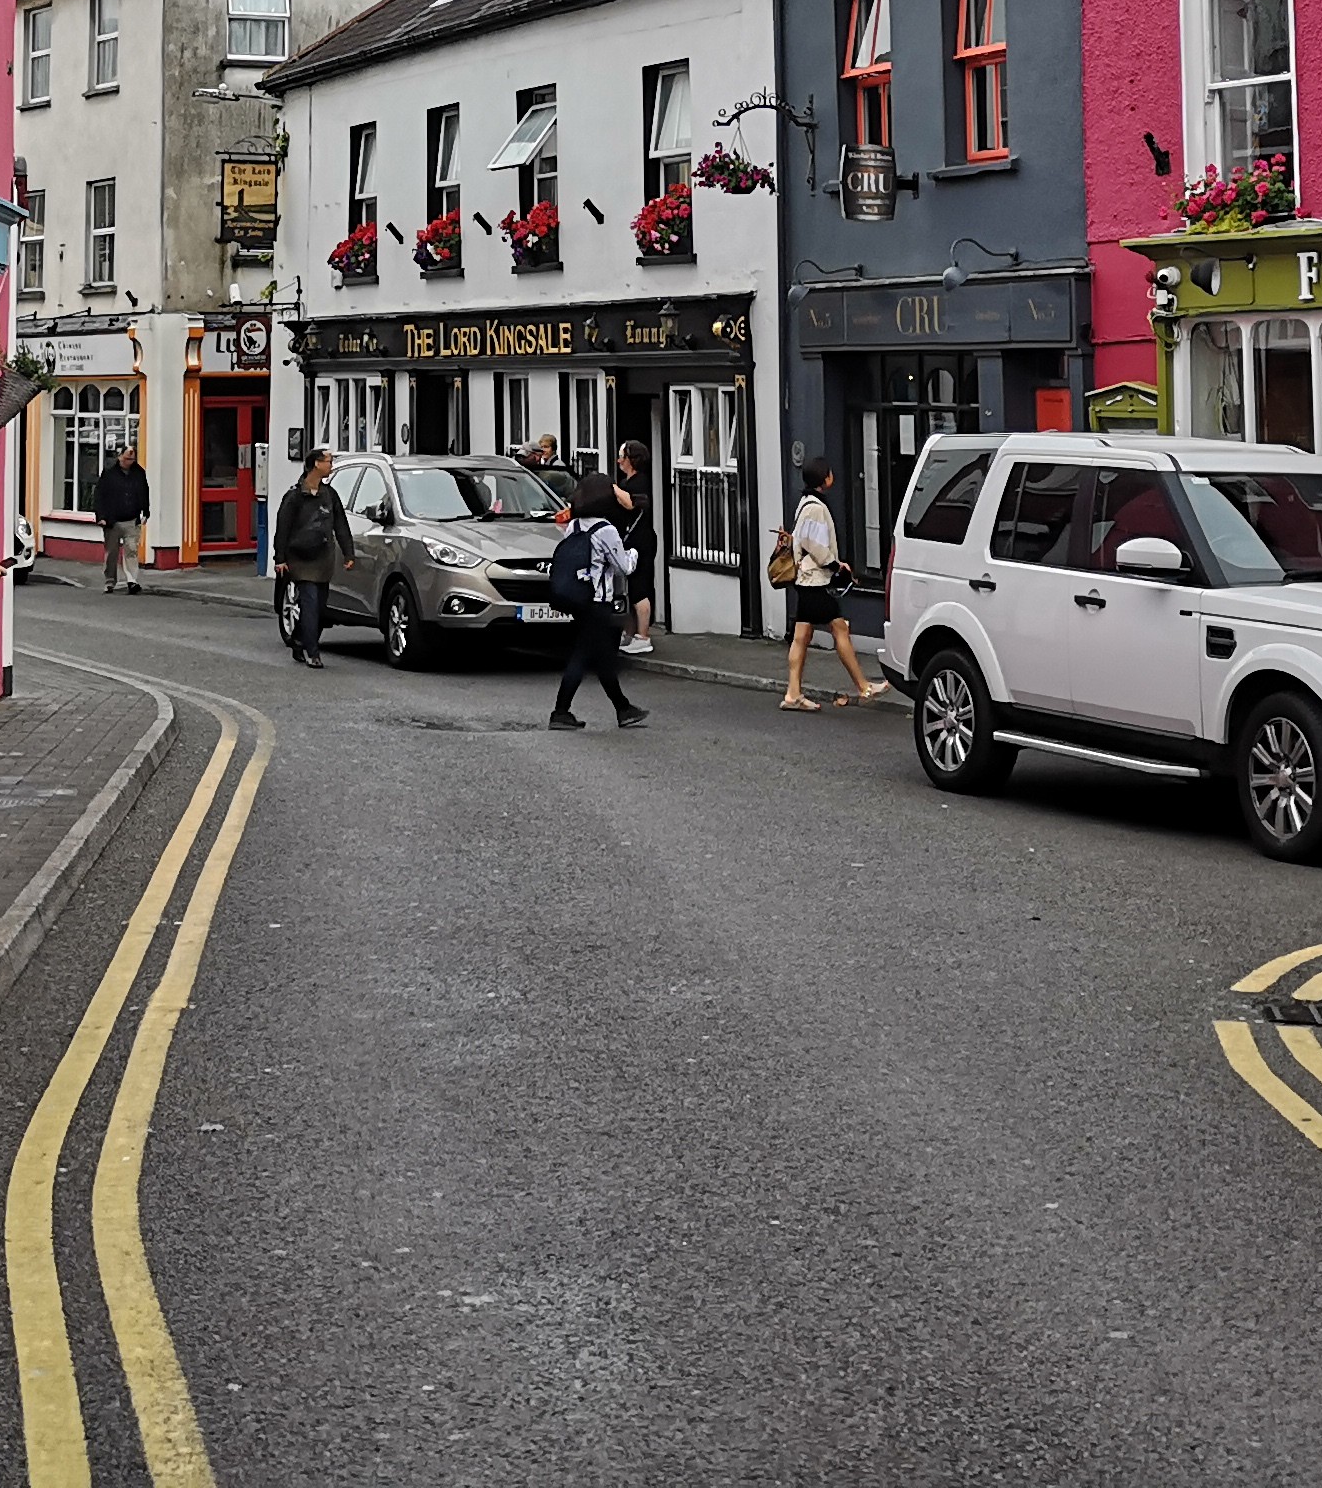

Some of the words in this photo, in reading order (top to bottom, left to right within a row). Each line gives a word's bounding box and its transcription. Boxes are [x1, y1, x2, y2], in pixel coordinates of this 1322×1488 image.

[847, 172, 894, 194] CRU
[896, 295, 949, 336] CRU
[403, 324, 434, 358] THE
[439, 322, 481, 356] LORD
[486, 319, 573, 356] KINGSALE
[626, 319, 667, 348] Loung
